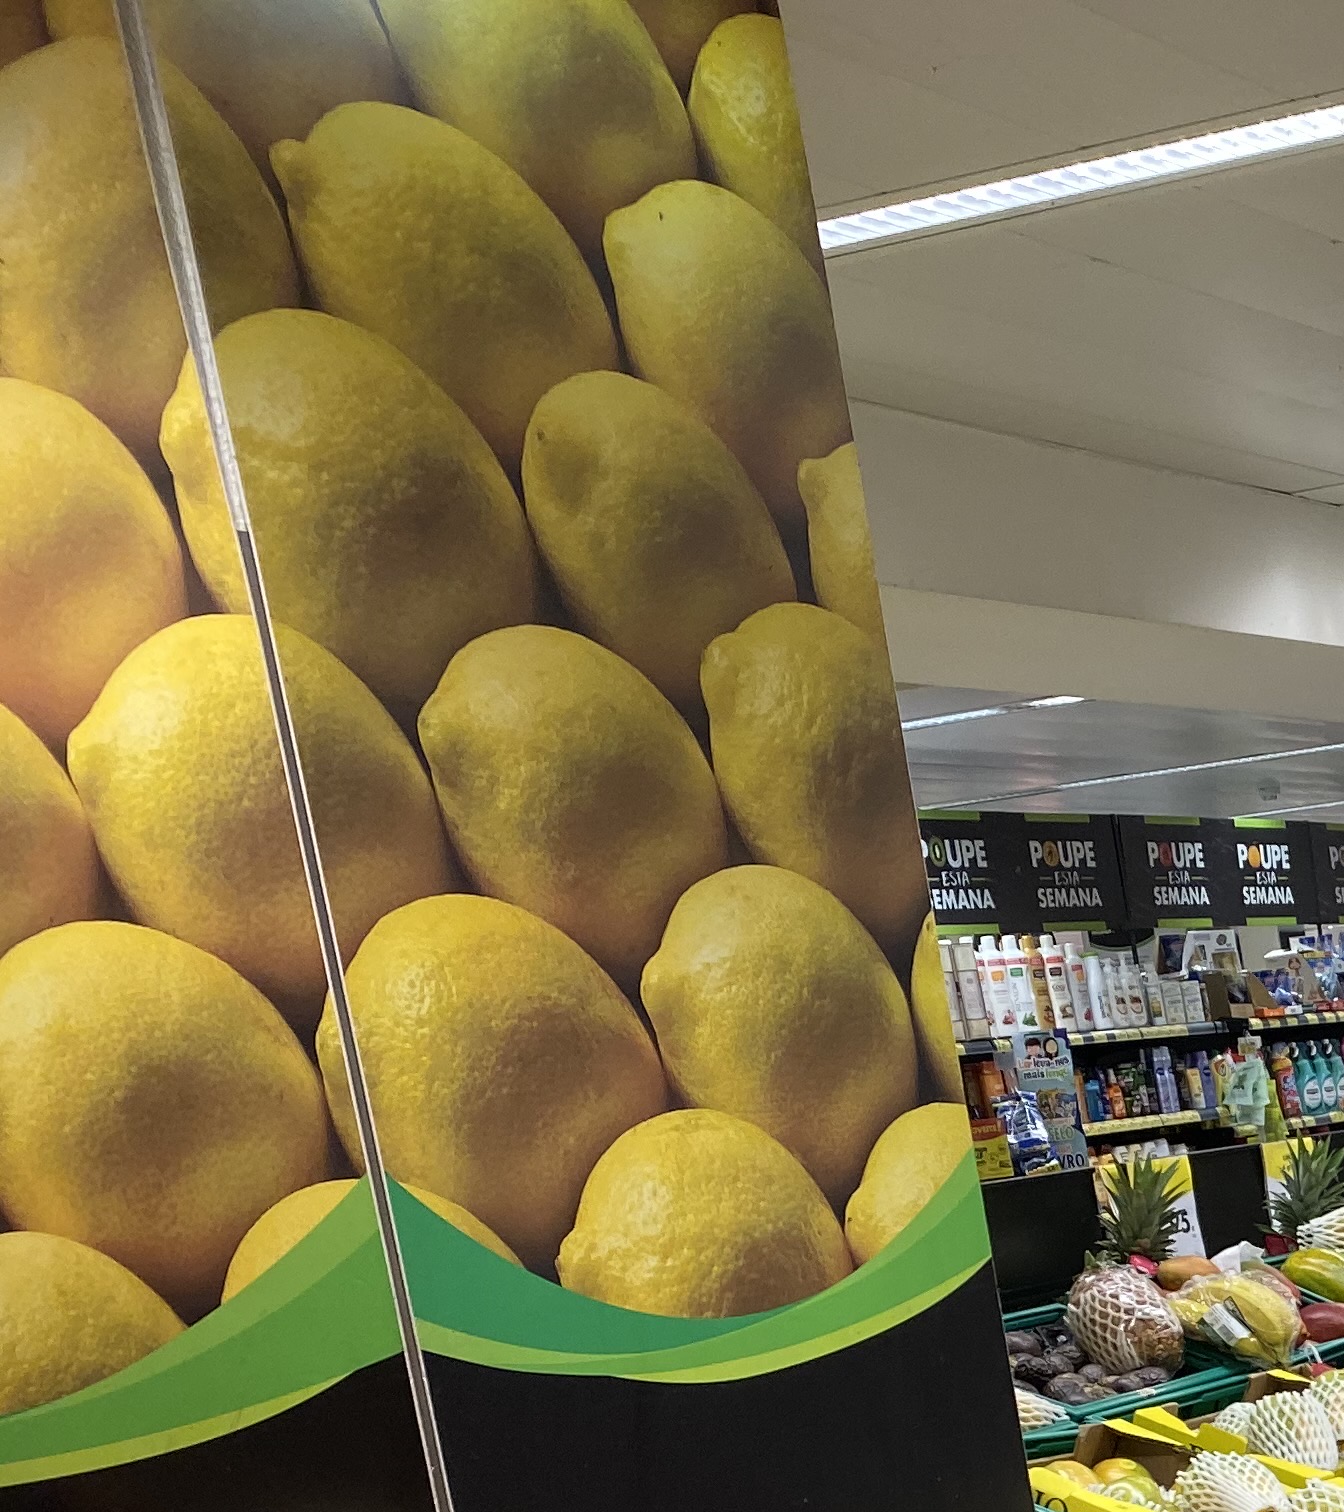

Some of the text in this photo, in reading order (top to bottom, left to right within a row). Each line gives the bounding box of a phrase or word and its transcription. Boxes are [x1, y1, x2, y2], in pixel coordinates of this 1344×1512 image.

[1029, 839, 1097, 868] POUPE
[1147, 841, 1204, 868] POUPE
[1237, 841, 1290, 869] POUPE
[941, 871, 970, 887] ESTA
[1053, 871, 1080, 886] ESTA
[1168, 871, 1191, 885] ESTA
[1256, 872, 1277, 885] ESTA
[1038, 888, 1103, 908] SEMANA
[1153, 886, 1210, 906] SEMANA
[1242, 886, 1294, 905] SEMANA
